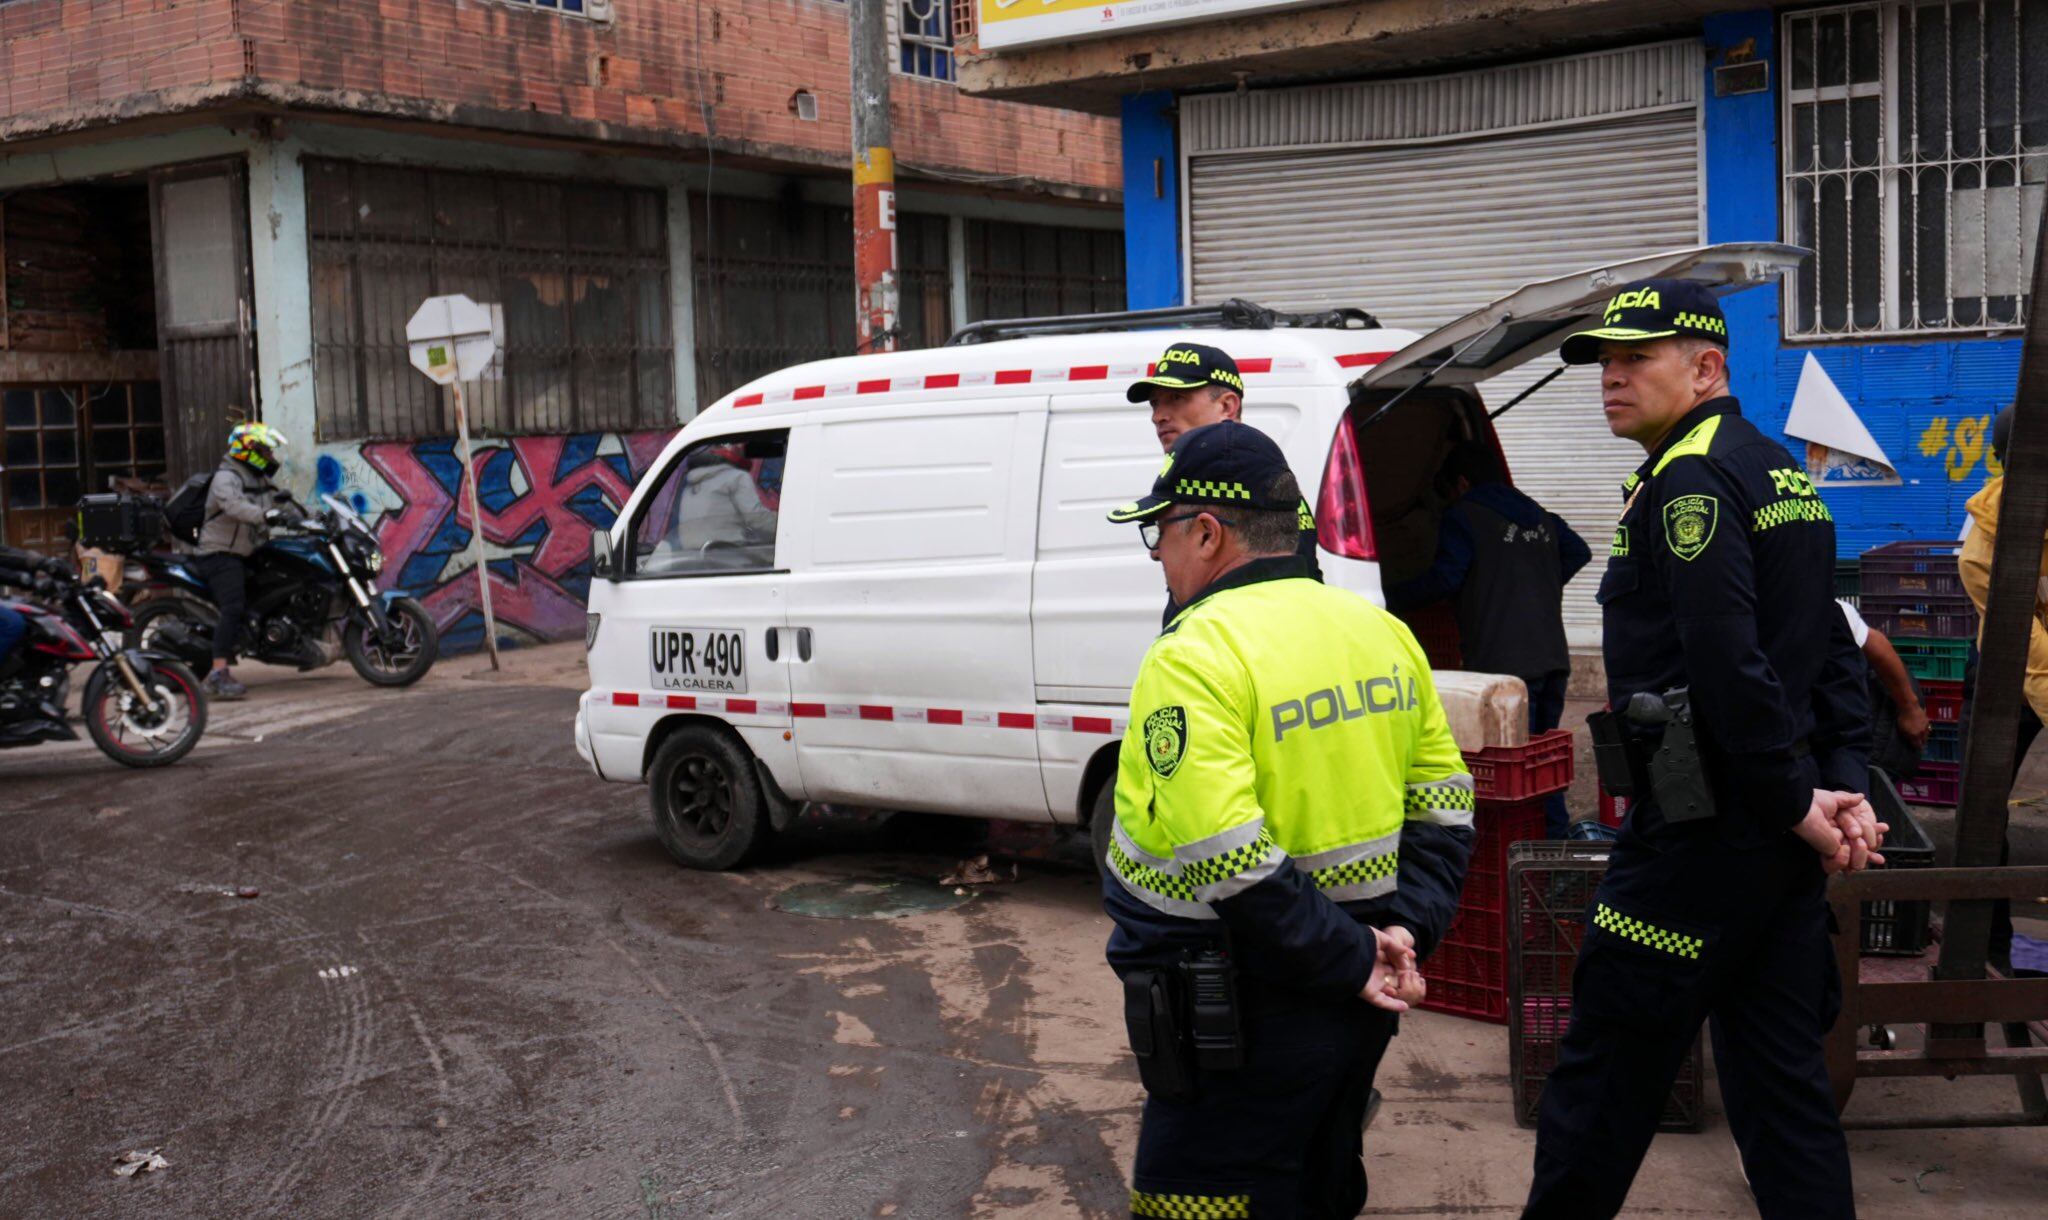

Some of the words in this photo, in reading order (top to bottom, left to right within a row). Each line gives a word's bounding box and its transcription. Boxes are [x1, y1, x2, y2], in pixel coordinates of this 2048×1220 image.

[1603, 286, 1661, 320] LICÍA
[663, 678, 680, 688] LA
[682, 678, 734, 690] CALERA
[1270, 663, 1419, 743] POLICÍA
